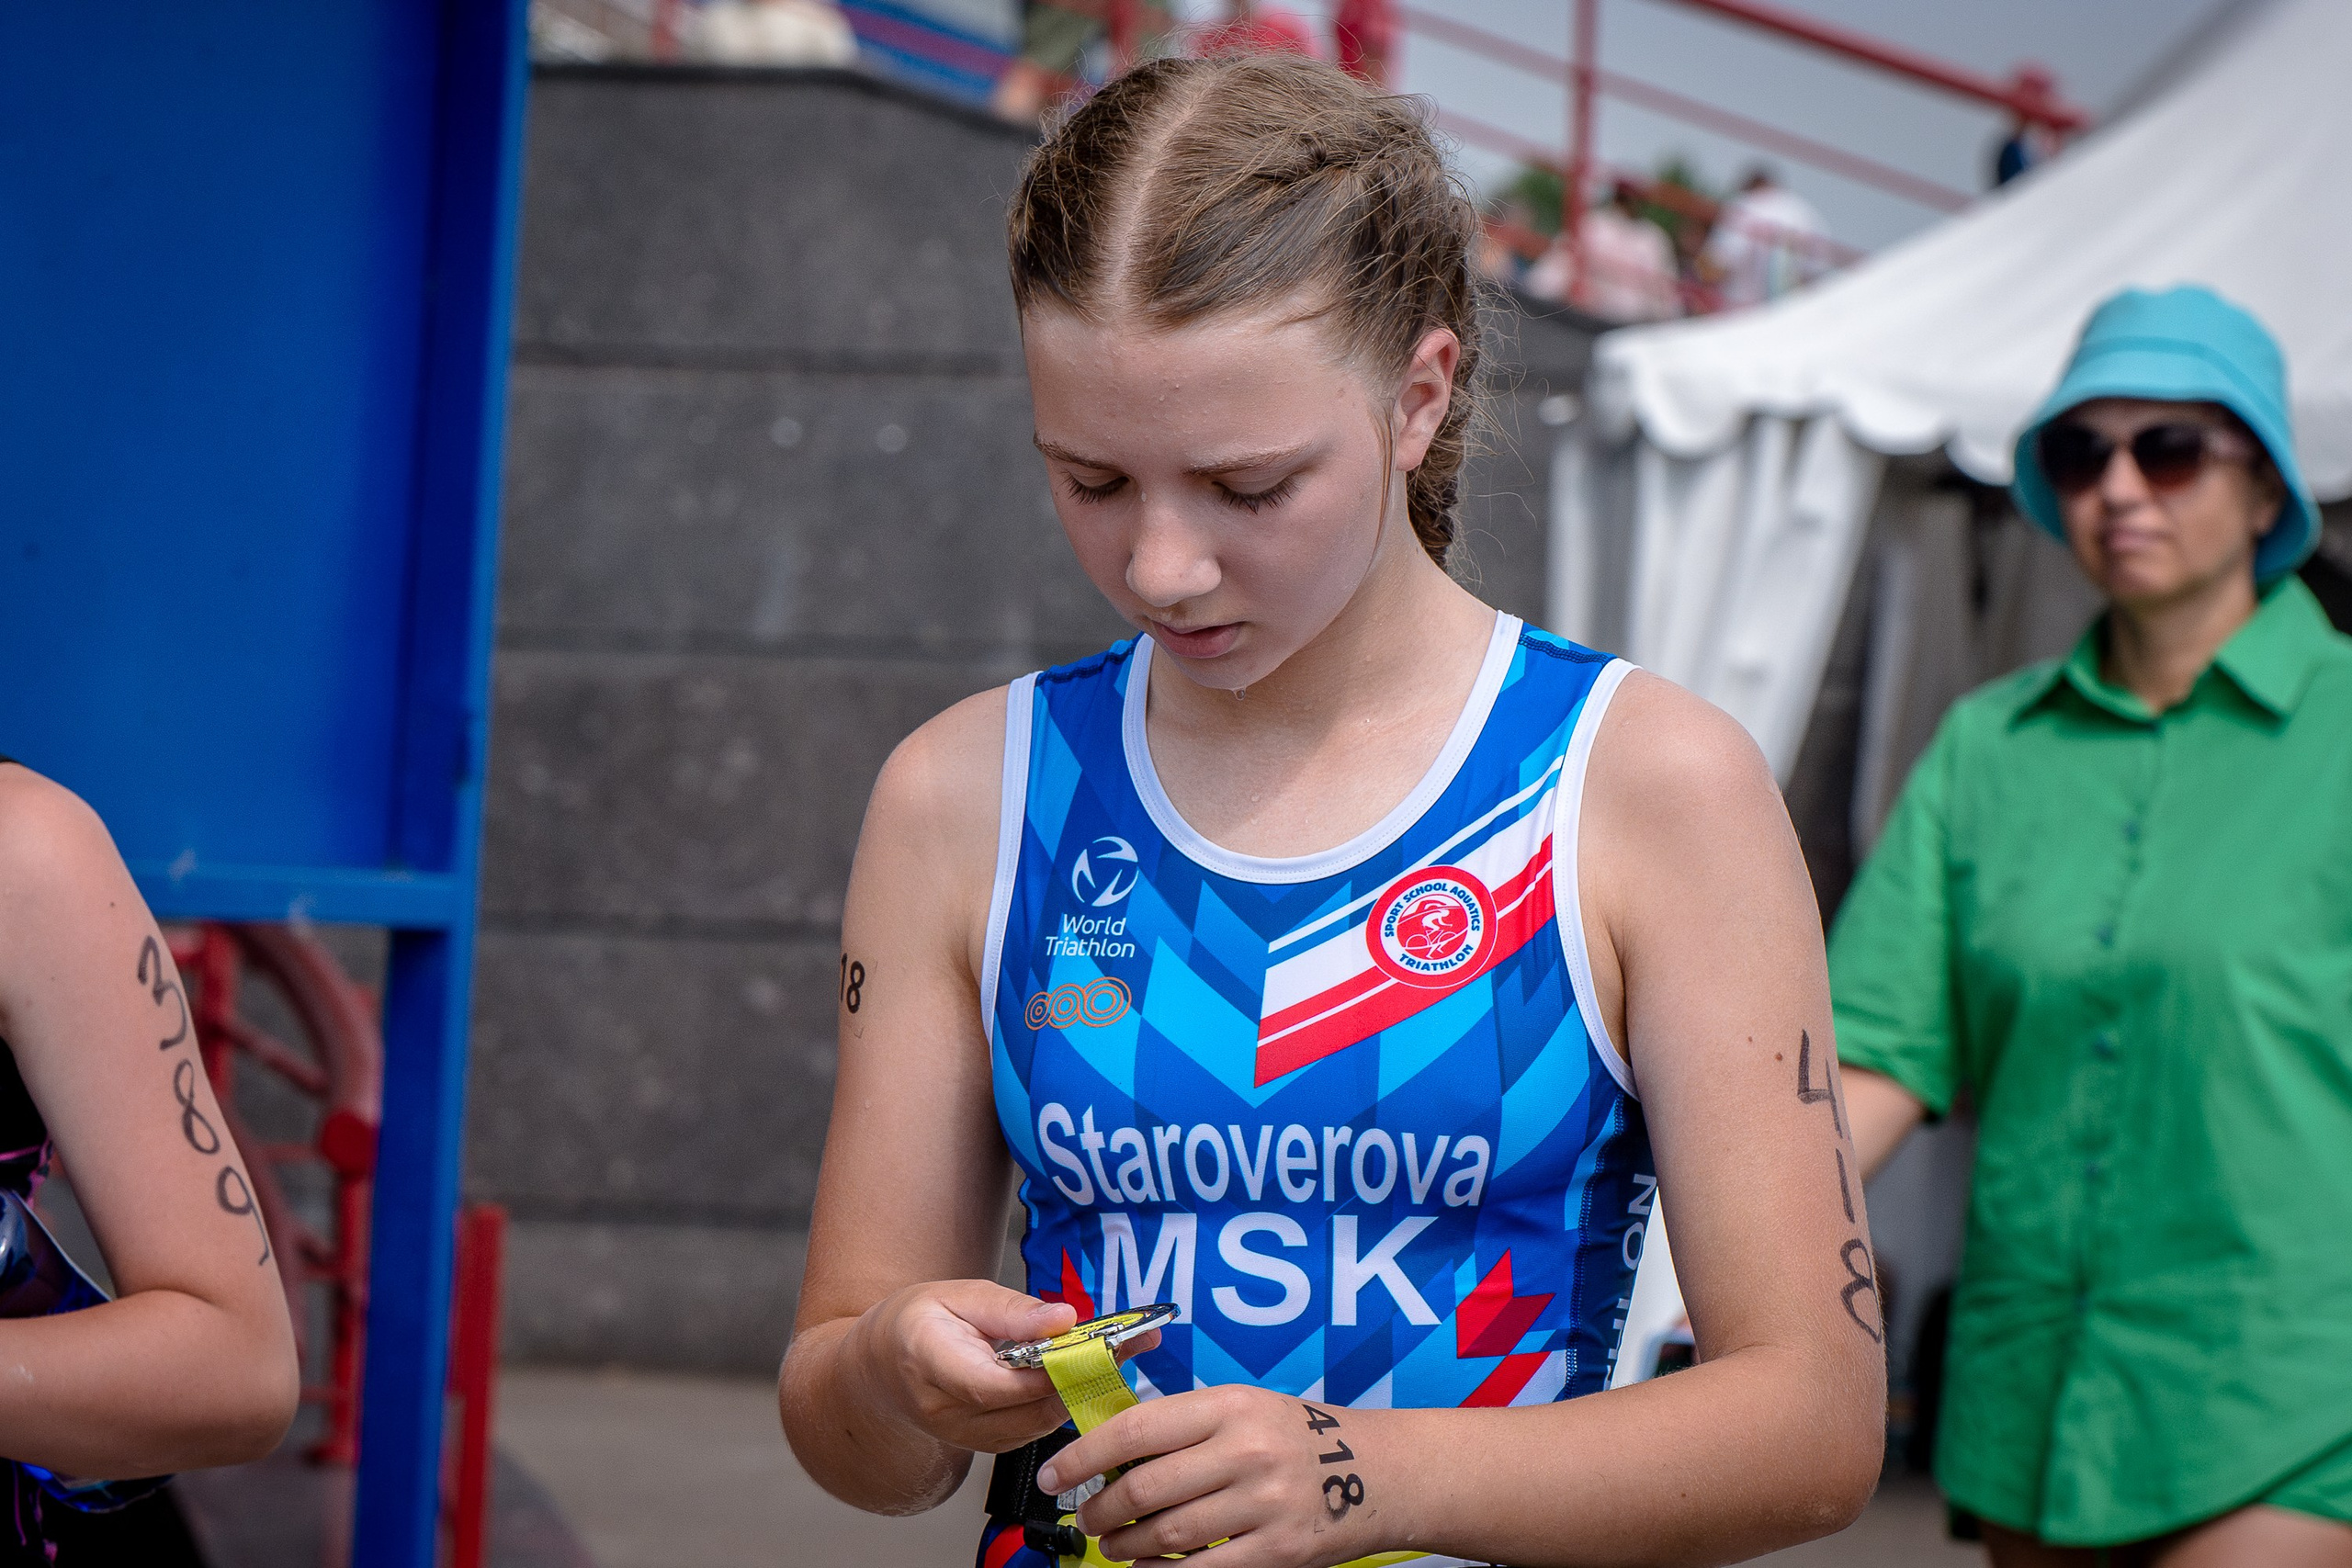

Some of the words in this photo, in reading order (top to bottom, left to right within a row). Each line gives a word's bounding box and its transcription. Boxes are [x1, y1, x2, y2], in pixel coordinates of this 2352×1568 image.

[1046, 936, 1136, 958] Triathlon
[1063, 913, 1126, 936] World
[1385, 901, 1405, 937] SPORT
[1403, 882, 1448, 903] SCHOOL
[1449, 886, 1480, 931] AQUATICS
[1398, 943, 1474, 971] TRIATHLON
[137, 934, 270, 1267] 389
[1038, 1102, 1490, 1207] Staroverova
[1796, 1028, 1883, 1344] 418
[1099, 1211, 1442, 1326] MSK
[1301, 1404, 1365, 1522] 418
